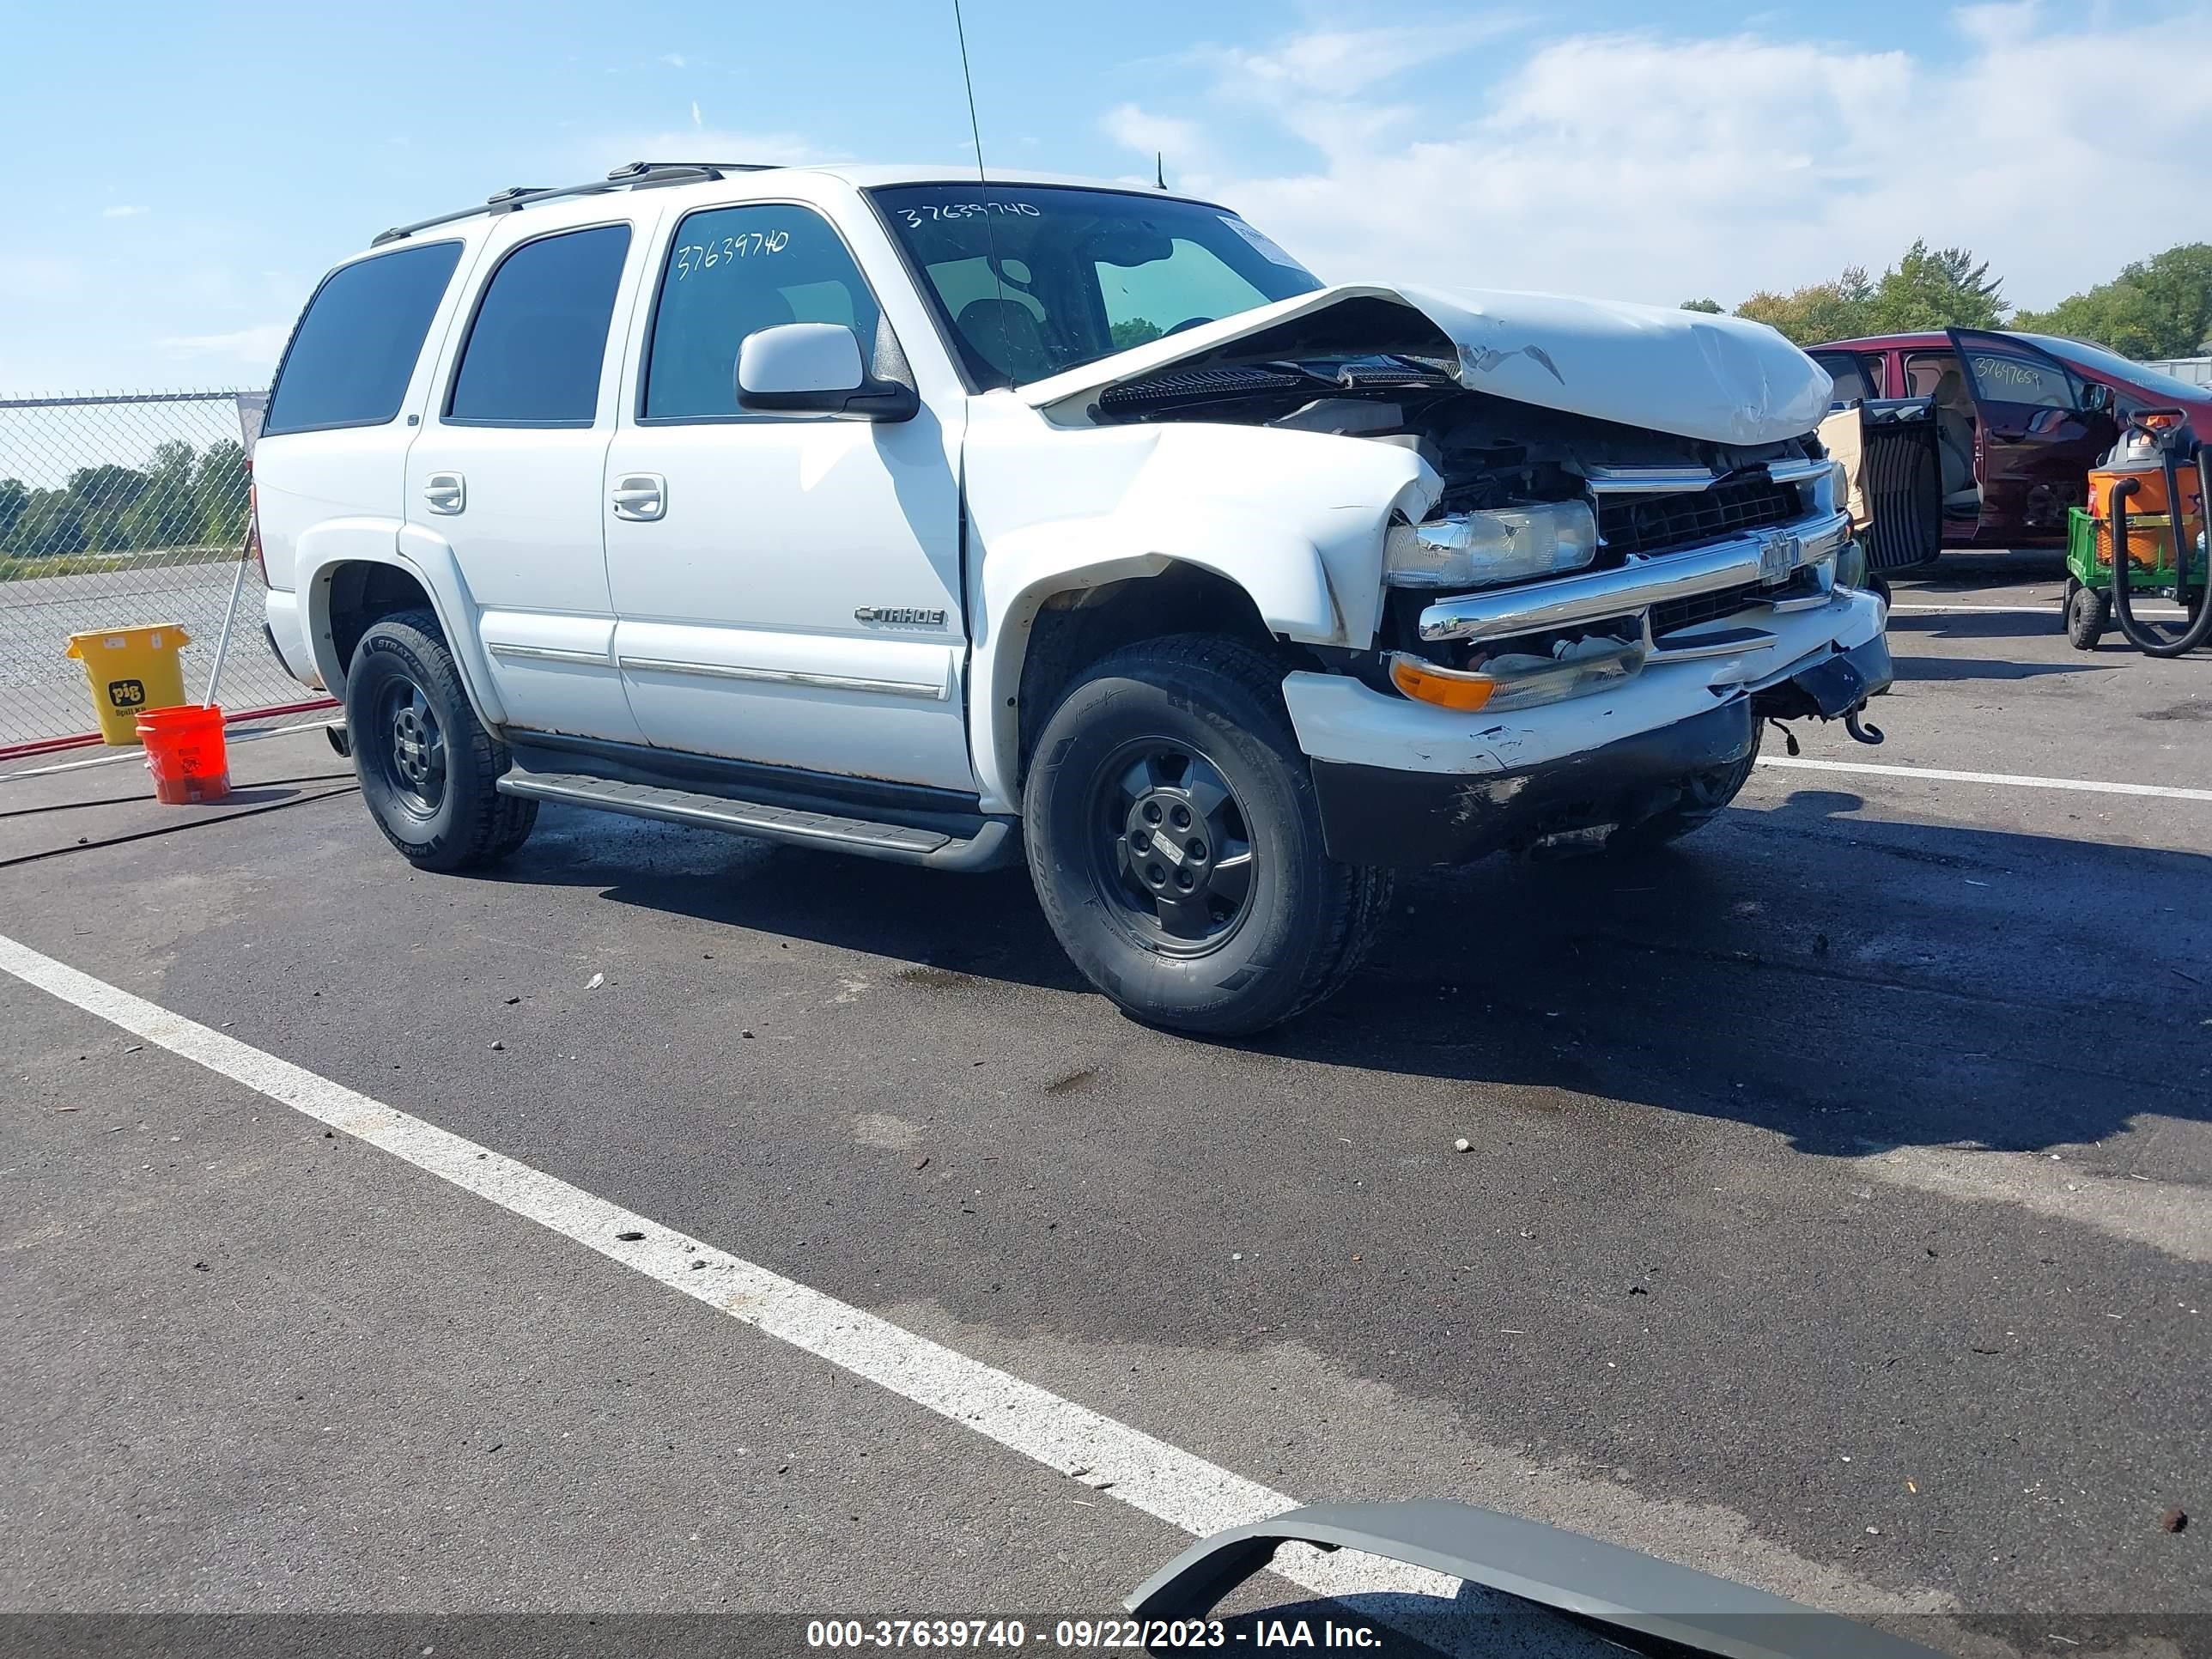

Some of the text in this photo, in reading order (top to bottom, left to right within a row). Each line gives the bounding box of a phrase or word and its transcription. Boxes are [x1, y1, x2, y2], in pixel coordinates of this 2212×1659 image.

[896, 202, 1041, 228] 37639740
[678, 229, 789, 282] 37639740
[1975, 357, 2039, 392] 37647659
[878, 606, 945, 625] TAHOE
[112, 682, 142, 704] pig
[115, 707, 134, 718] Spill
